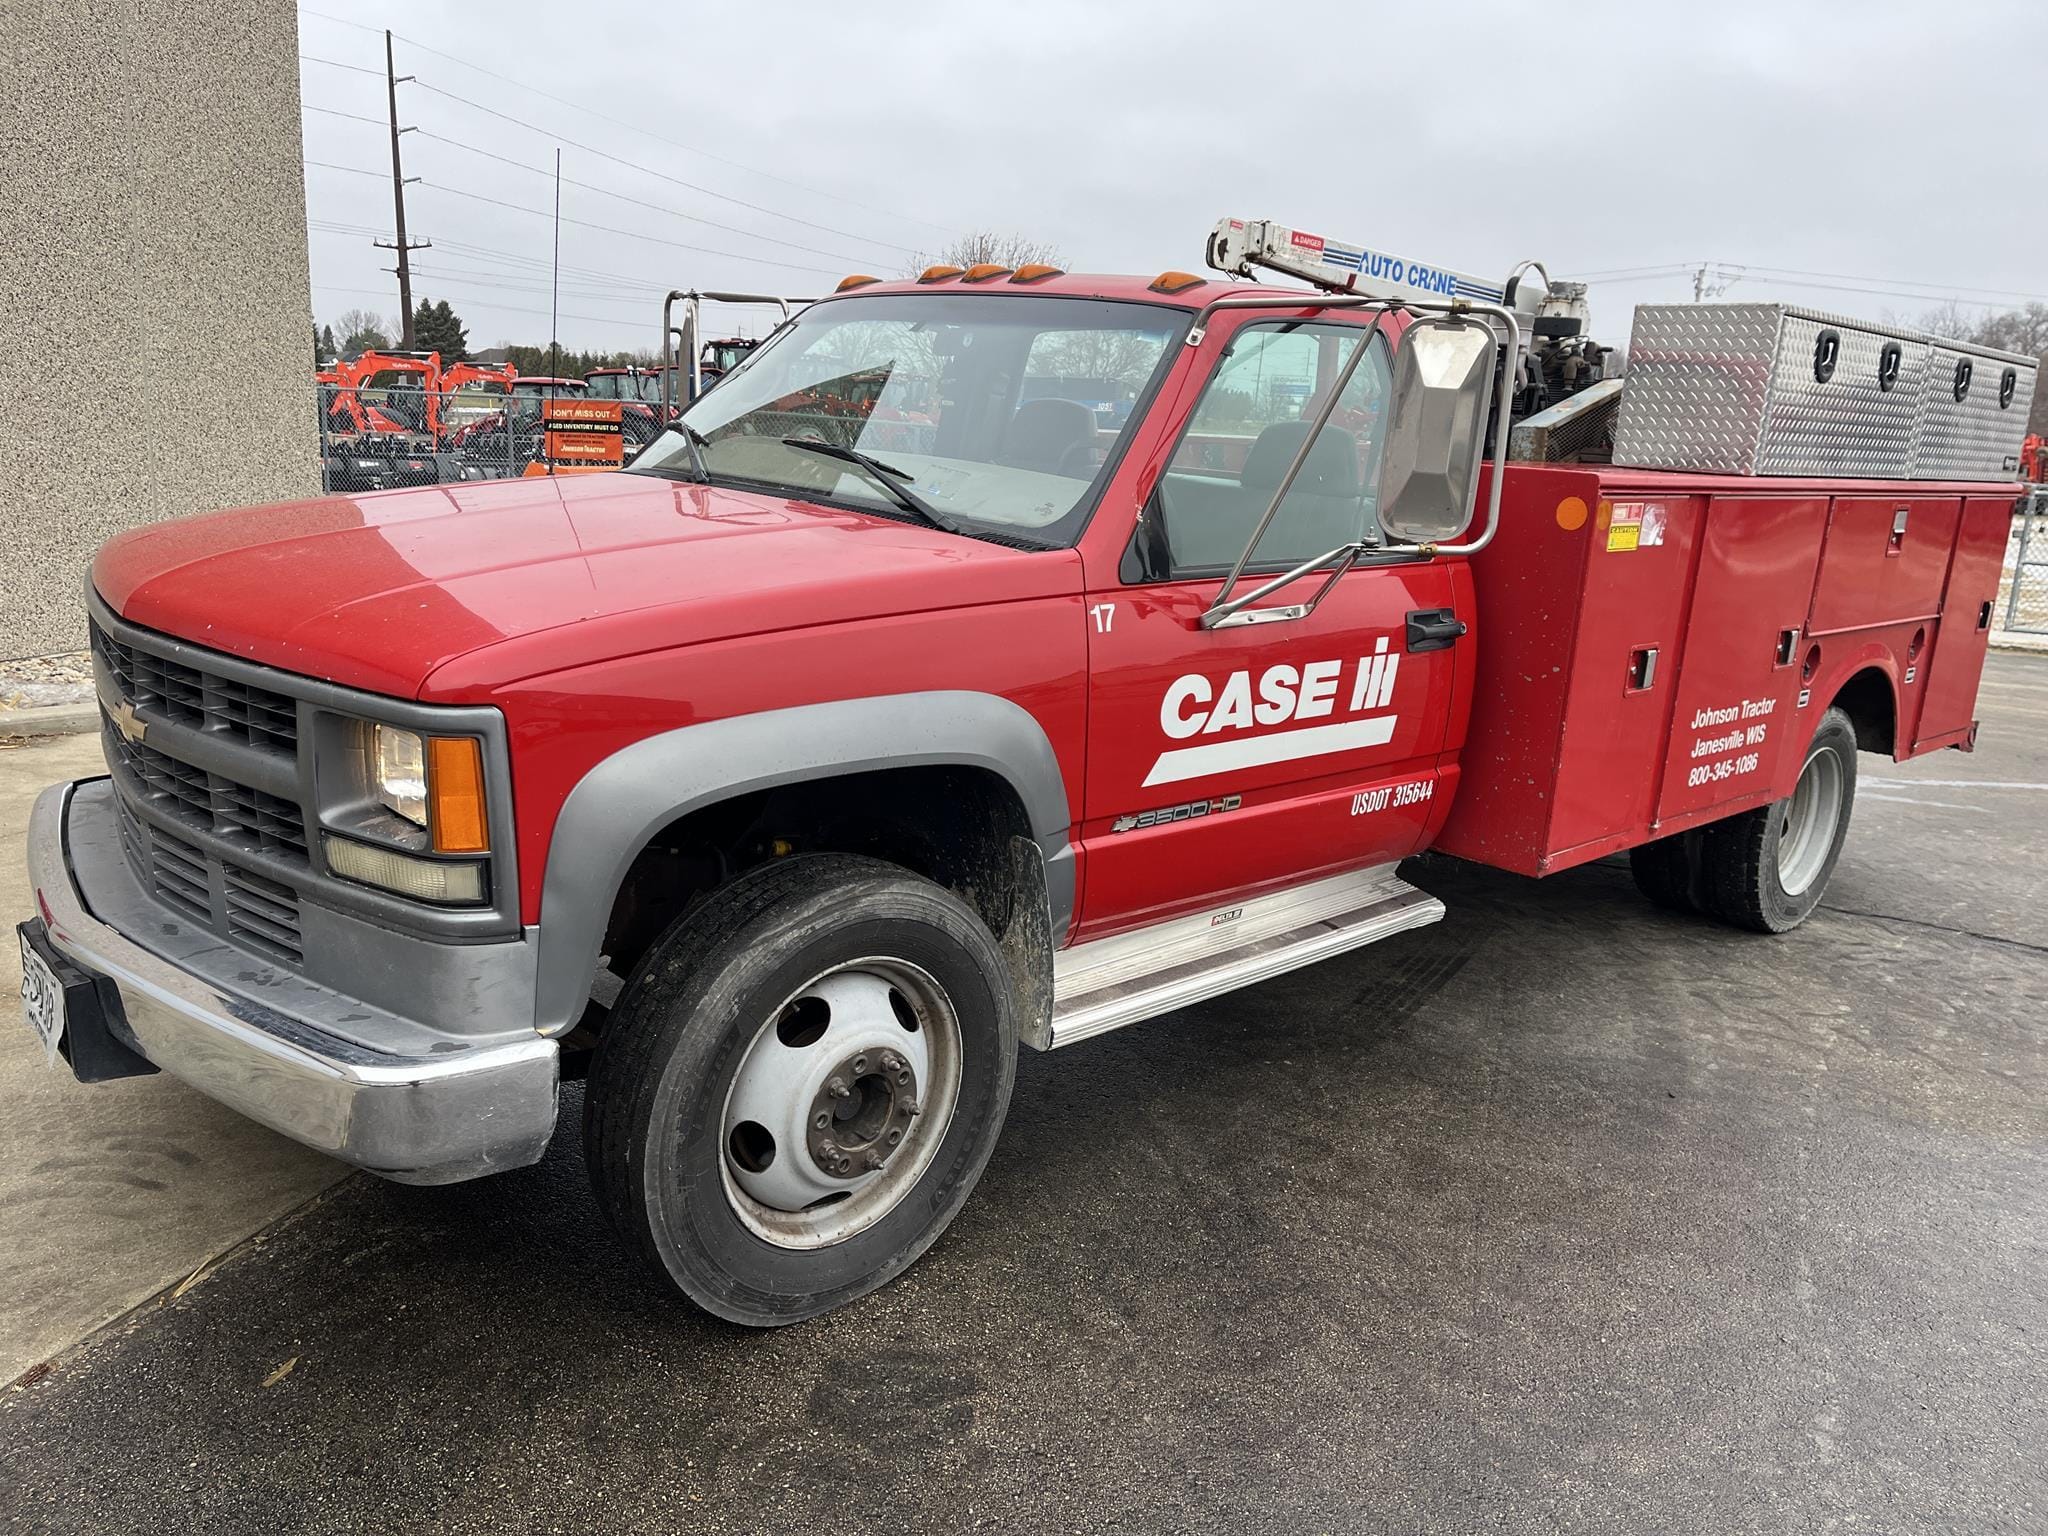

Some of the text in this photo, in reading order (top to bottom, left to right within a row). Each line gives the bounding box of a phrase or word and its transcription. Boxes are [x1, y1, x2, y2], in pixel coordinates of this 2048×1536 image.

[1299, 235, 1322, 247] DANGER
[1358, 251, 1457, 296] AUTO CRANE
[550, 408, 573, 418] DON'T
[575, 409, 594, 418] MISS
[595, 410, 610, 419] OUT
[563, 423, 593, 431] INVENTORY
[609, 424, 619, 432] GO
[1089, 603, 1115, 633] 17
[1160, 659, 1342, 739] CASE
[1691, 697, 1776, 730] Johnson Tractor
[1691, 723, 1767, 758] Janesville WIS
[1688, 752, 1759, 787] 800-345-1086
[1136, 794, 1242, 828] 3500HD
[1351, 779, 1434, 816] USDOT 315644
